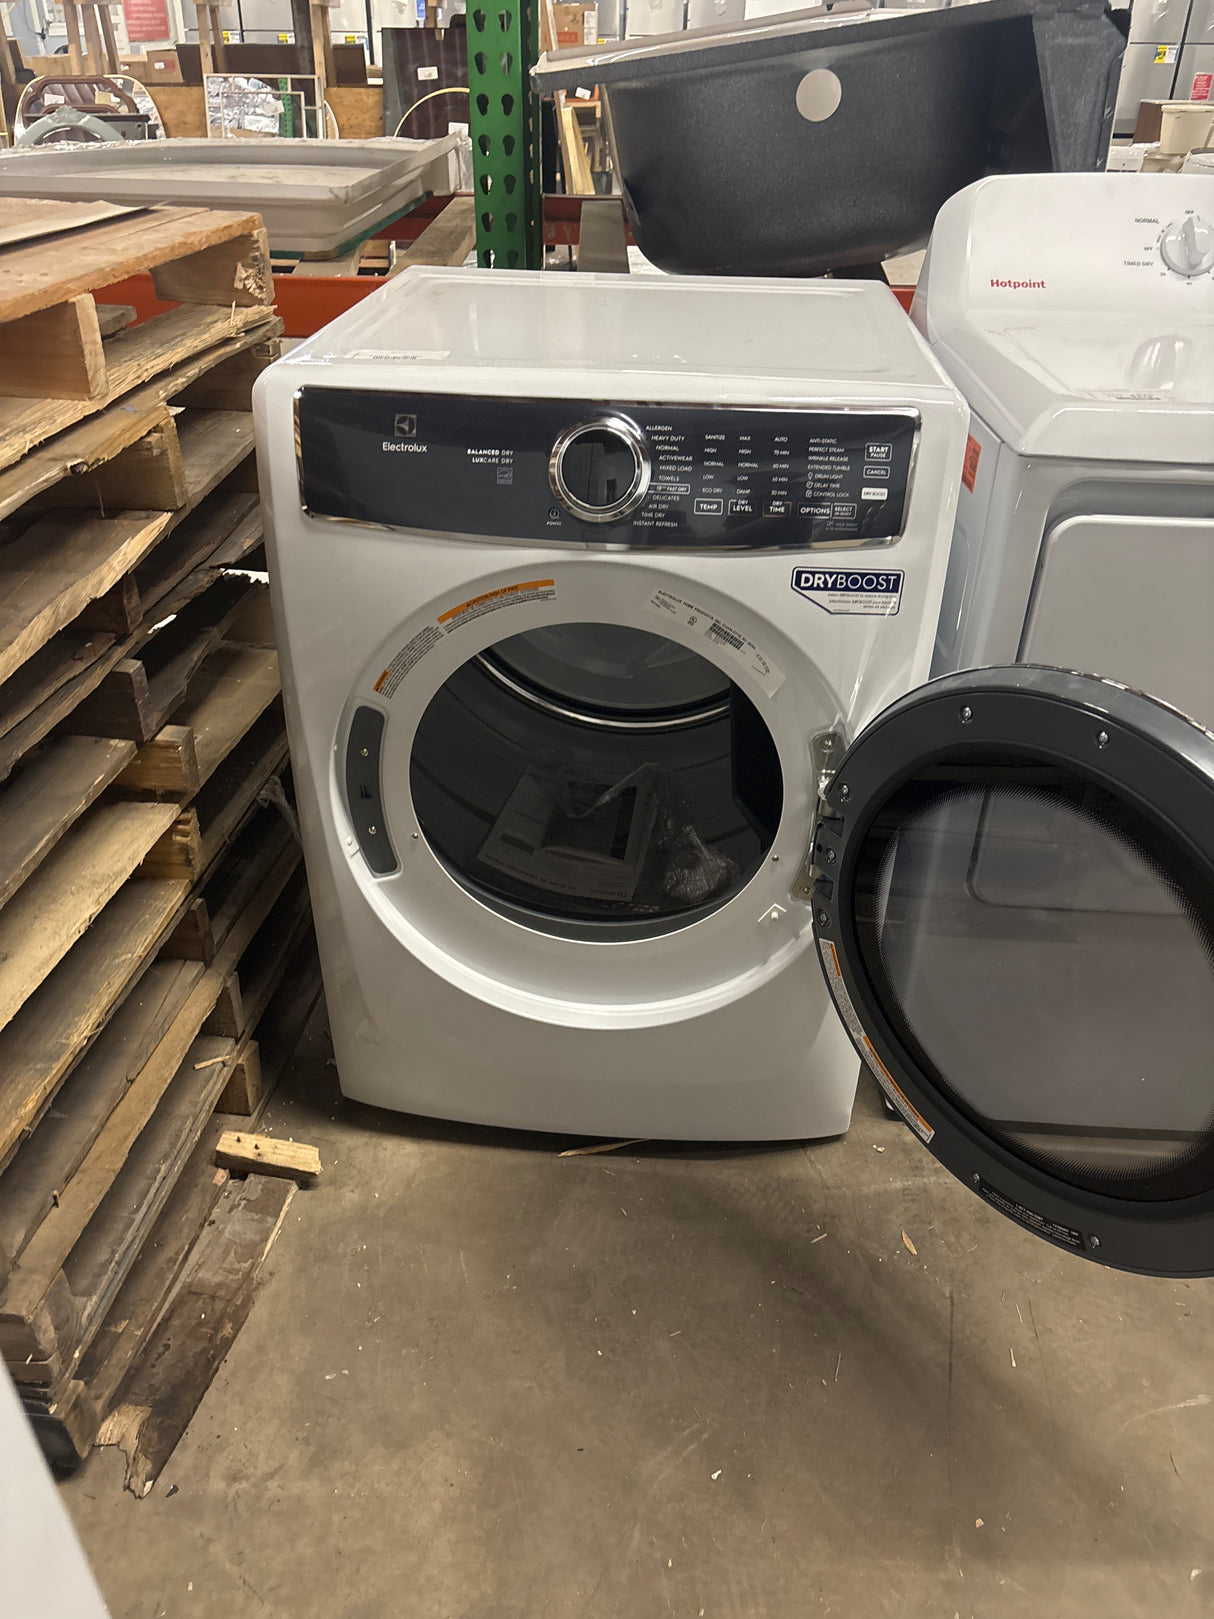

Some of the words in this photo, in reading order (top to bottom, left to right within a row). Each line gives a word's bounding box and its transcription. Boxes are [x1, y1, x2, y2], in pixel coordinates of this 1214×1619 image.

[990, 278, 1046, 290] Hotpoint
[382, 442, 428, 453] Electrolux
[800, 573, 898, 590] DRYBOOST
